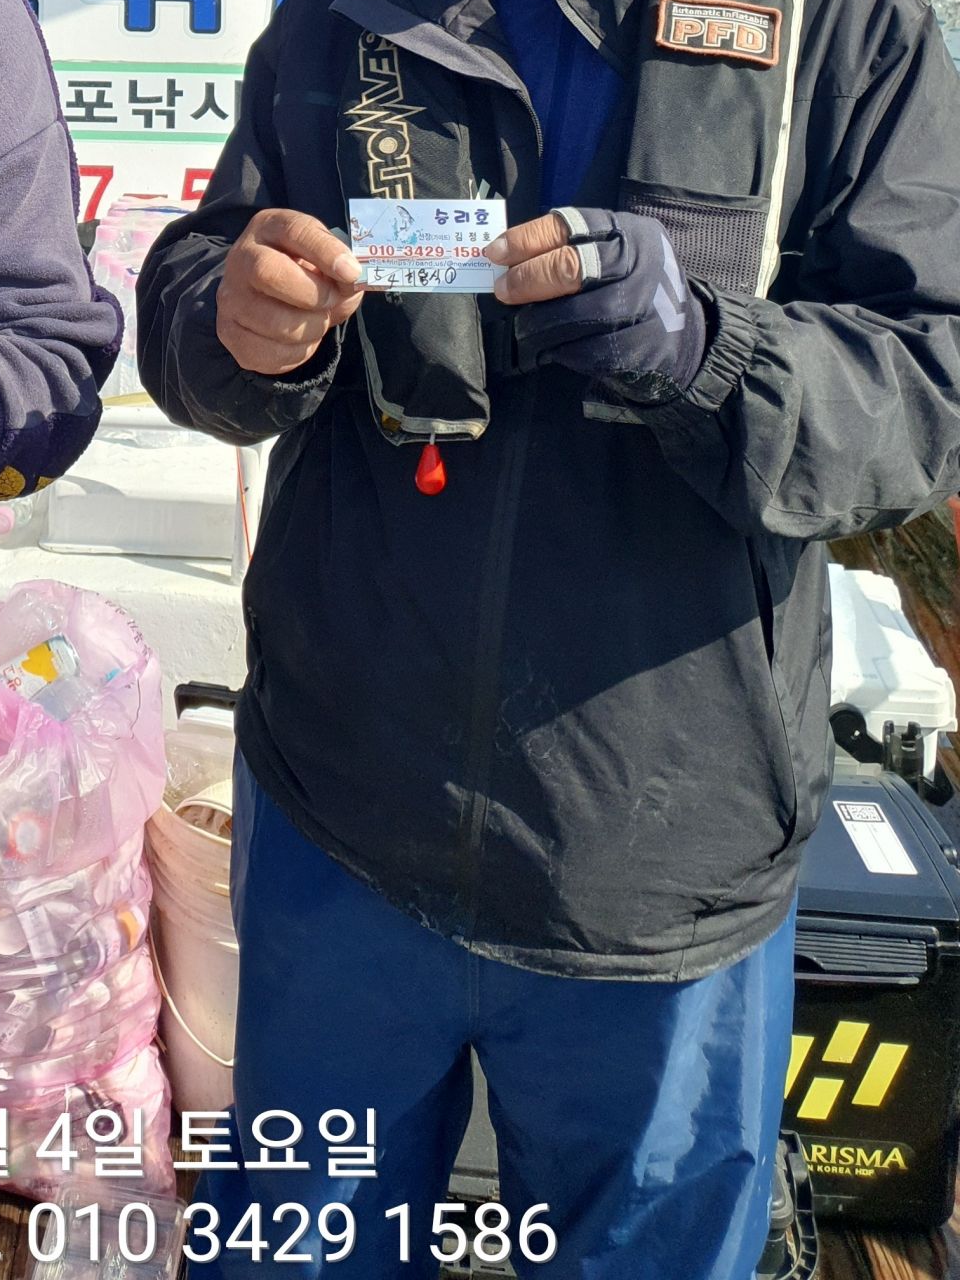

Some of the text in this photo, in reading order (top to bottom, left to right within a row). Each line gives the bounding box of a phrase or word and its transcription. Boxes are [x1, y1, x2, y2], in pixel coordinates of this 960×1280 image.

[672, 5, 721, 17] Automatic
[670, 16, 768, 54] PFD
[434, 208, 489, 226] 승리호
[817, 1165, 852, 1175] KOREA
